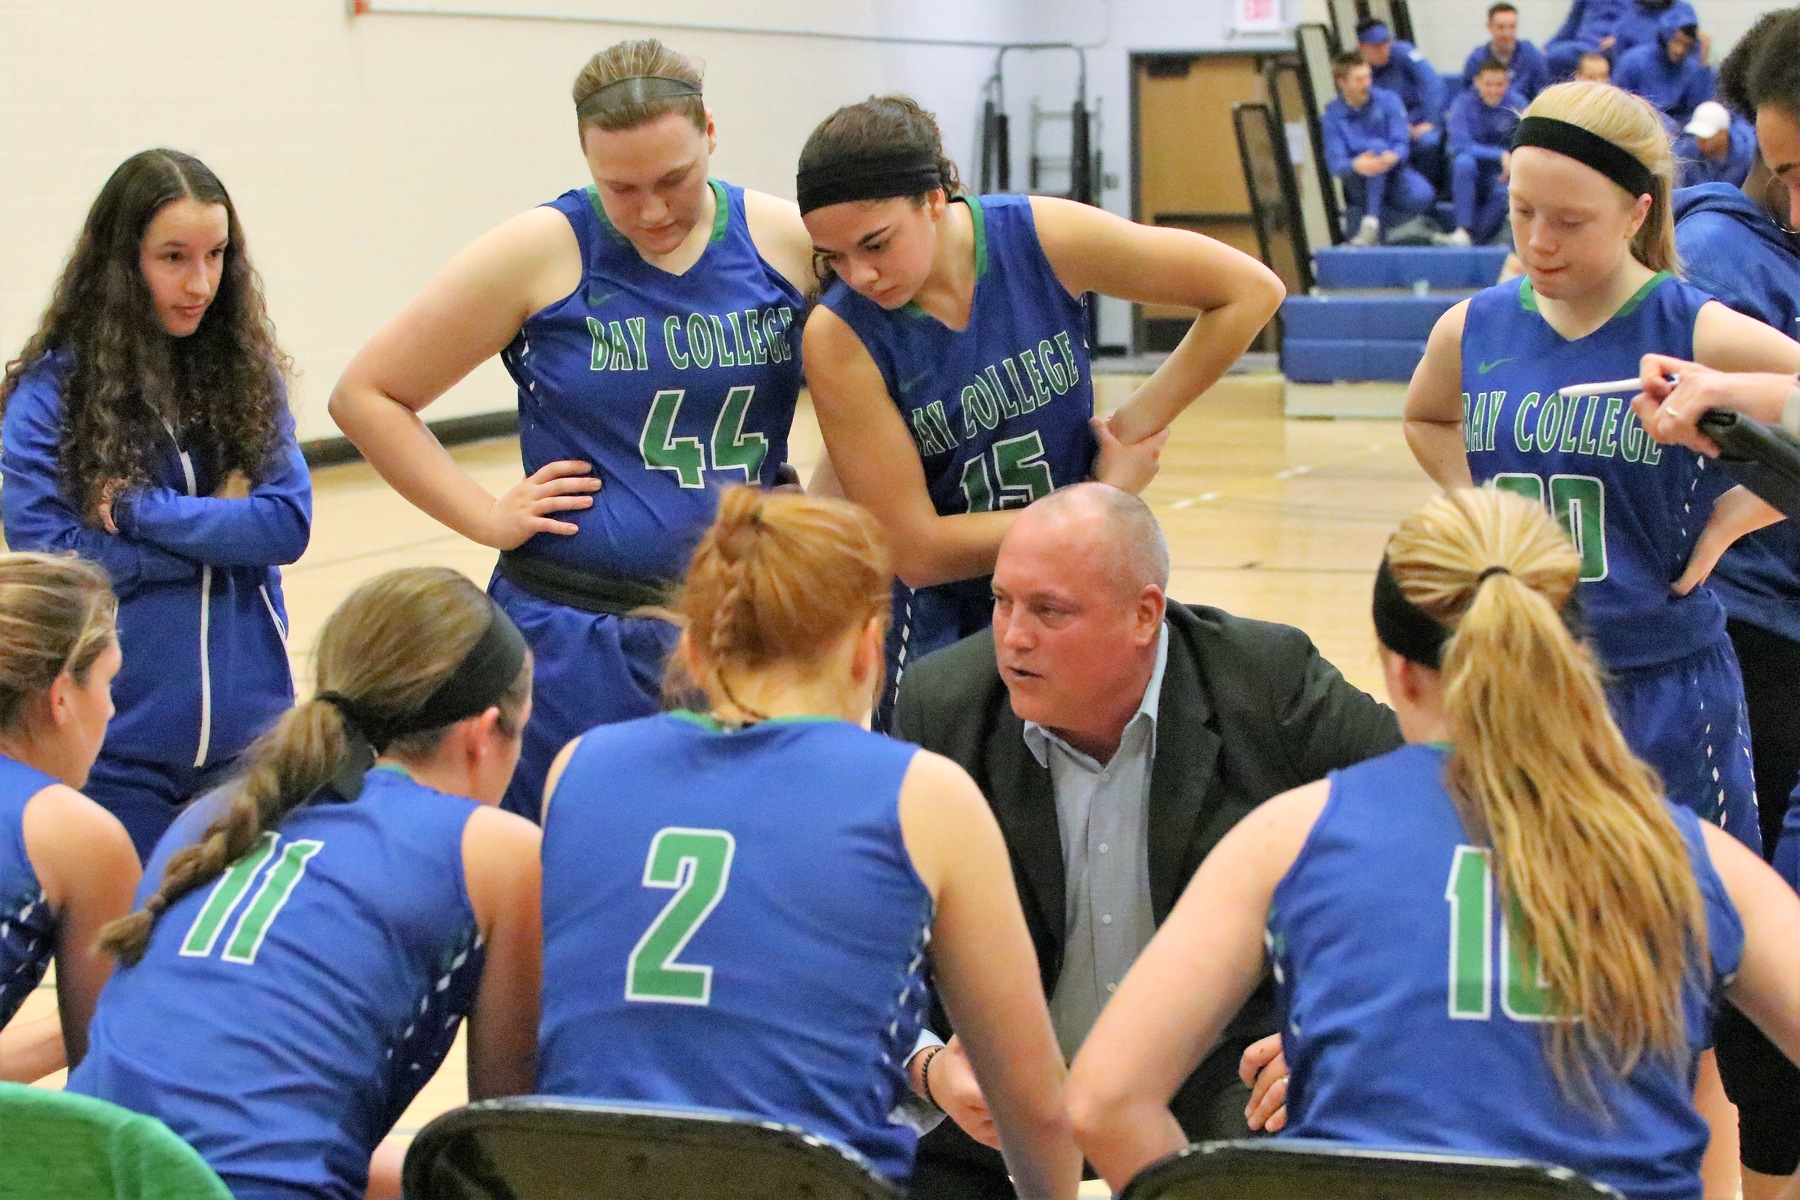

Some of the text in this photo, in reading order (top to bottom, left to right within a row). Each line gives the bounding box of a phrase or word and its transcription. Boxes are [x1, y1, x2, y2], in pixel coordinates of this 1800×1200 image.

[586, 307, 793, 371] BAY COLLEGE
[914, 330, 1079, 456] AY COLLEGE
[639, 385, 769, 489] 44
[960, 430, 1054, 513] 15
[1492, 472, 1608, 582] 0
[178, 831, 325, 965] 11
[624, 826, 736, 1006] 2
